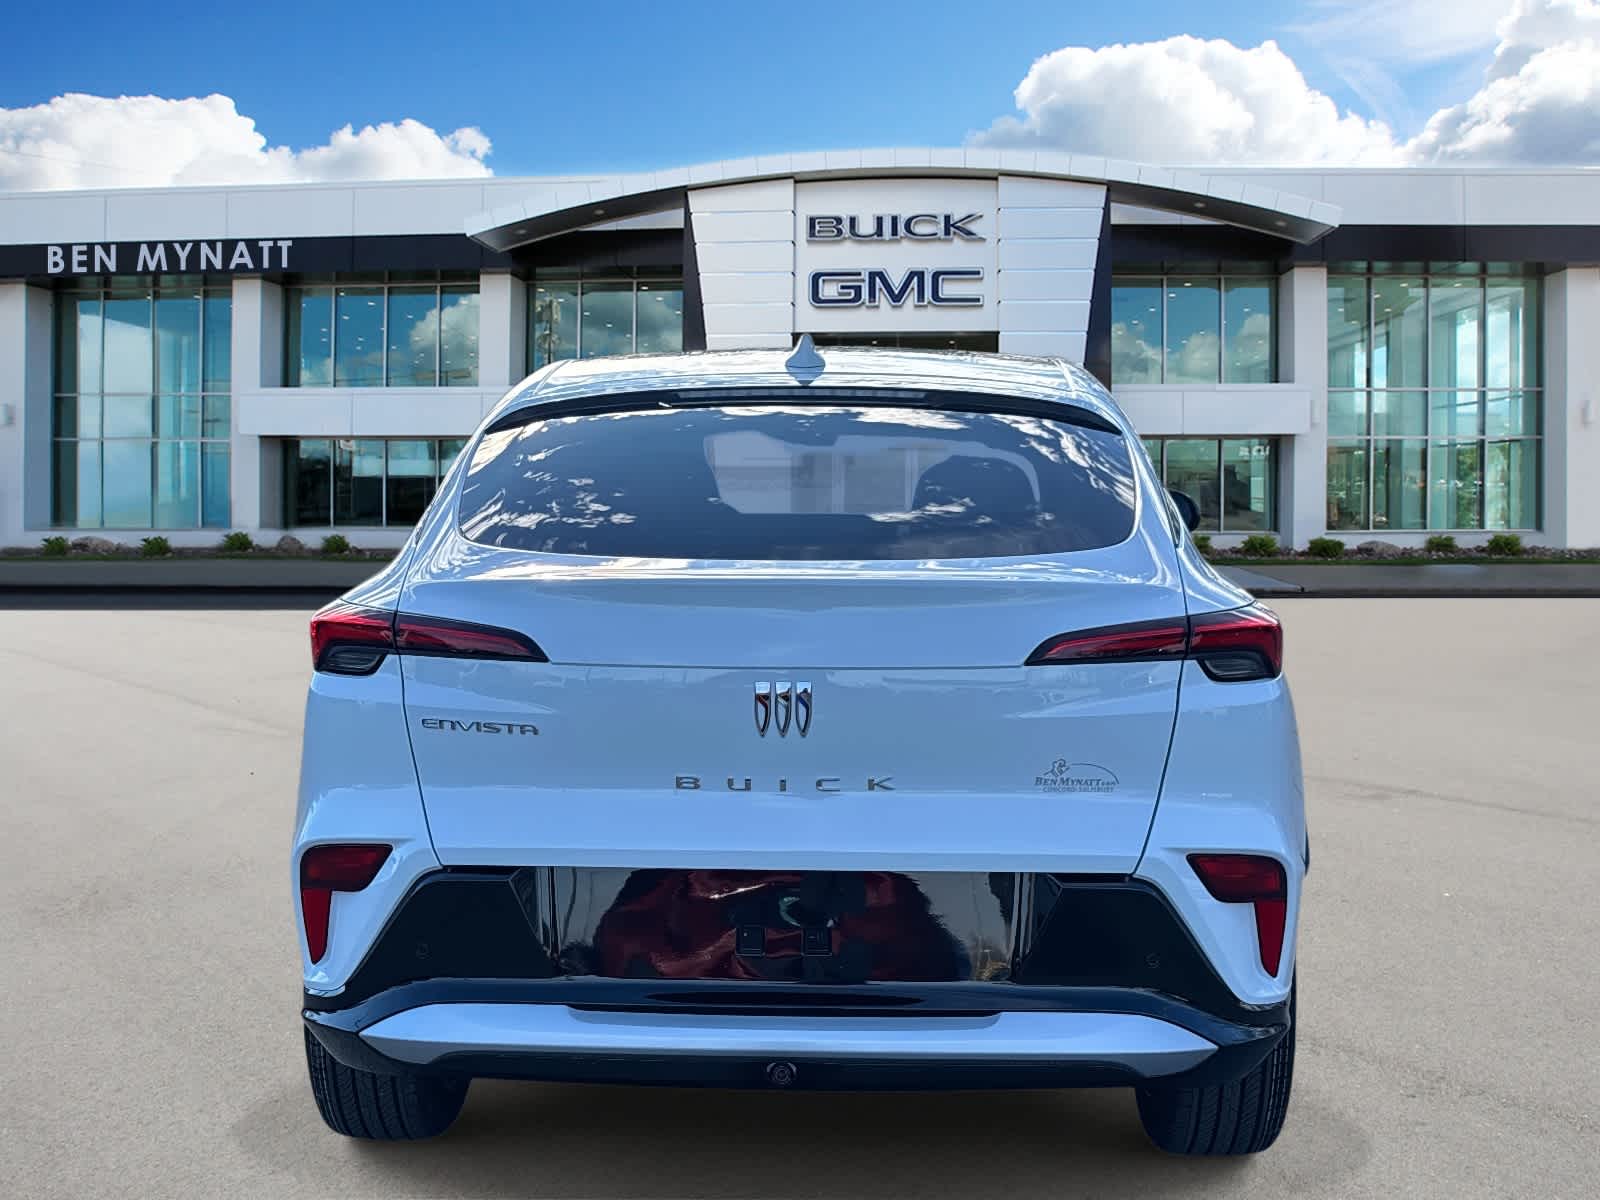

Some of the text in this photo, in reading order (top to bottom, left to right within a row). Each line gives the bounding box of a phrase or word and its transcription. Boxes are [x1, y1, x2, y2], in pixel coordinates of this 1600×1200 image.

[806, 213, 987, 242] BUICK
[47, 240, 293, 274] BEN MYNATT
[809, 267, 985, 309] GMC
[421, 718, 539, 735] ENVISTA
[675, 775, 897, 792] BUICK
